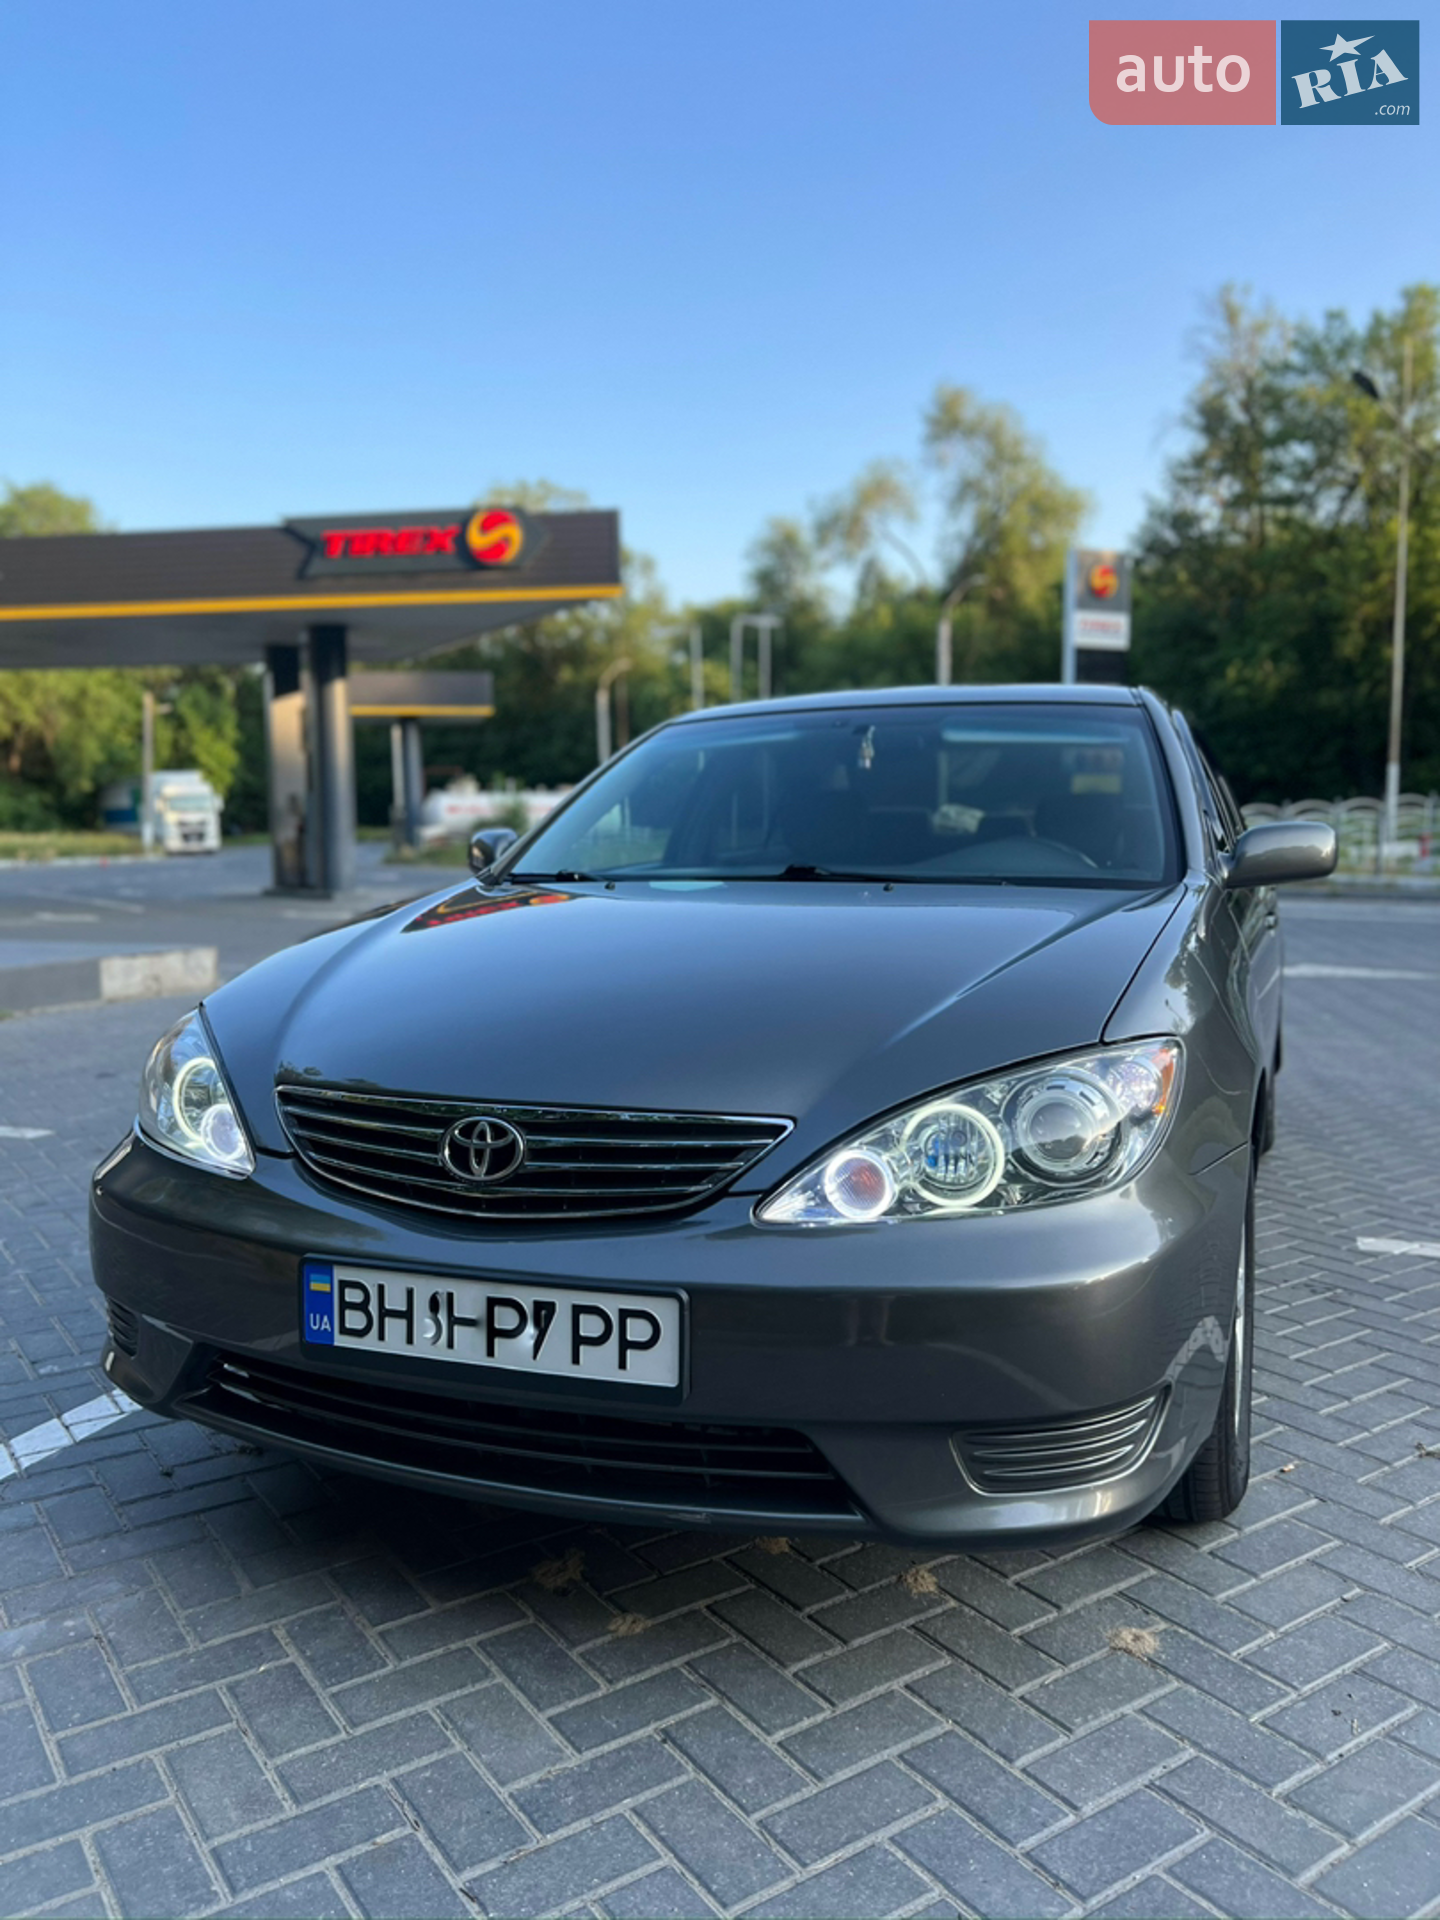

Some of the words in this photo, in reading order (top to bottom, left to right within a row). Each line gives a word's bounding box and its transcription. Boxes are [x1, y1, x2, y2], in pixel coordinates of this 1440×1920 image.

[321, 524, 462, 558] TIREX
[309, 1313, 331, 1332] UA
[338, 1279, 414, 1346] BH
[572, 1303, 662, 1371] PP
